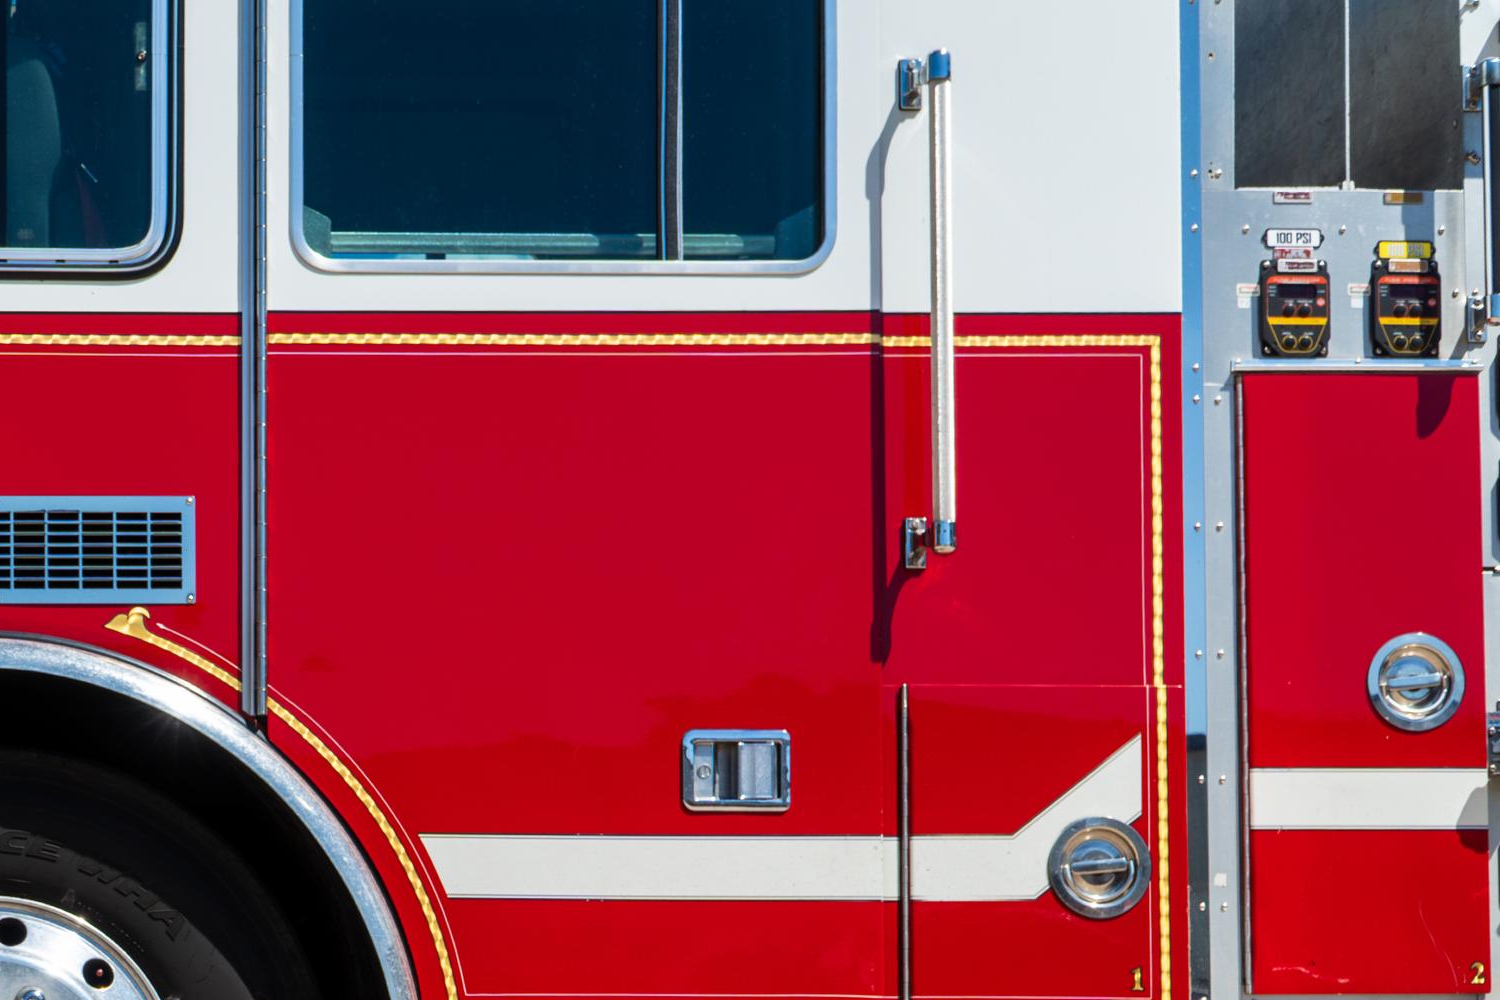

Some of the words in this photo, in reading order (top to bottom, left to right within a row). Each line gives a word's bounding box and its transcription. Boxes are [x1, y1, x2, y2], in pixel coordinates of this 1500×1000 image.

[1276, 232, 1293, 244] 100
[1295, 232, 1312, 244] PSI
[1130, 966, 1145, 992] 1
[1469, 961, 1486, 985] 2
